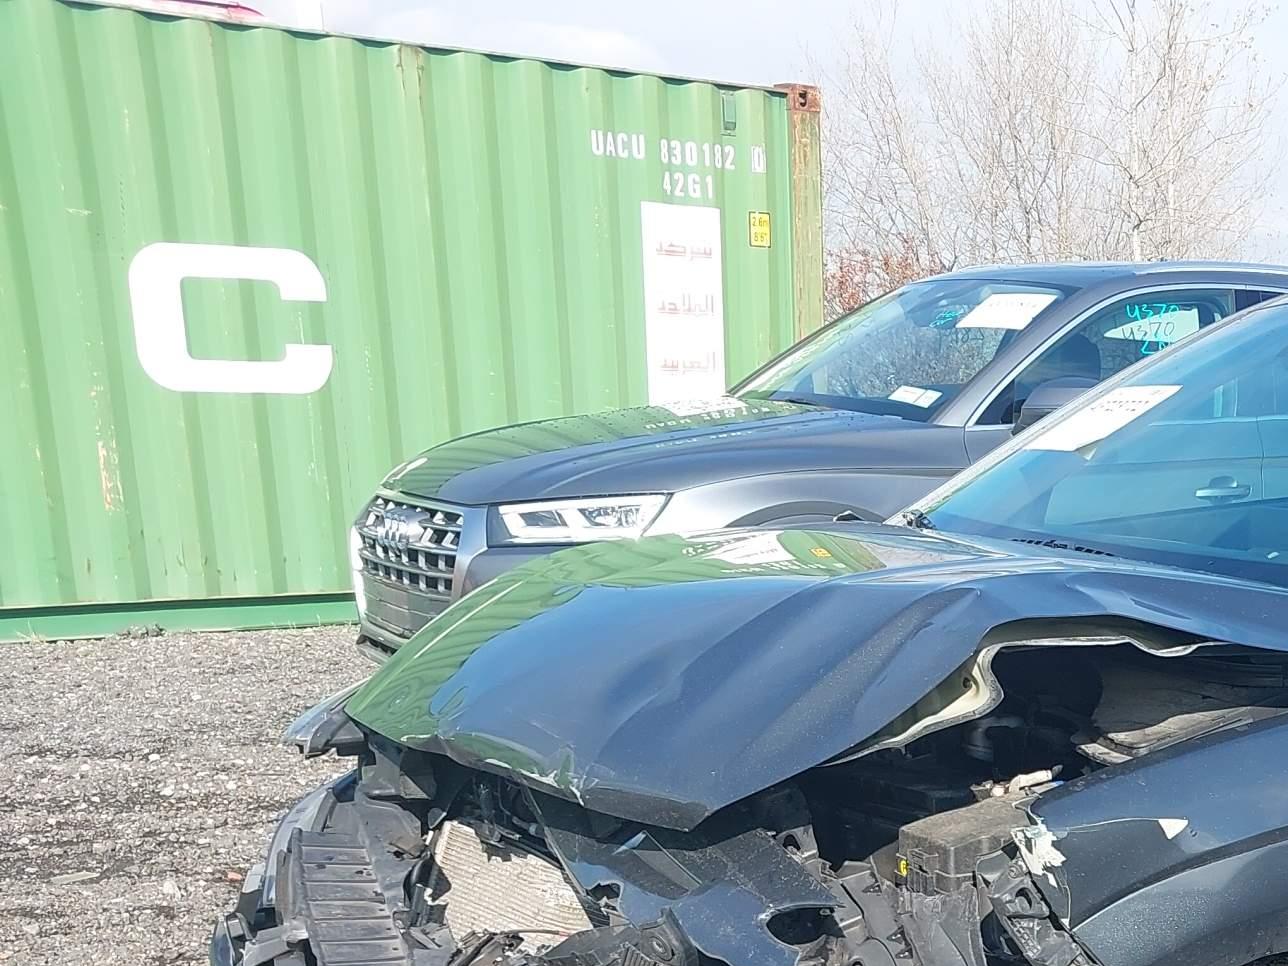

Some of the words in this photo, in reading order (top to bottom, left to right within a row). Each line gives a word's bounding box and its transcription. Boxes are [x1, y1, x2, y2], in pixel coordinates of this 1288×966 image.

[590, 129, 646, 160] UACU
[660, 139, 736, 170] 830182
[662, 171, 714, 199] 42G1
[128, 242, 334, 395] C
